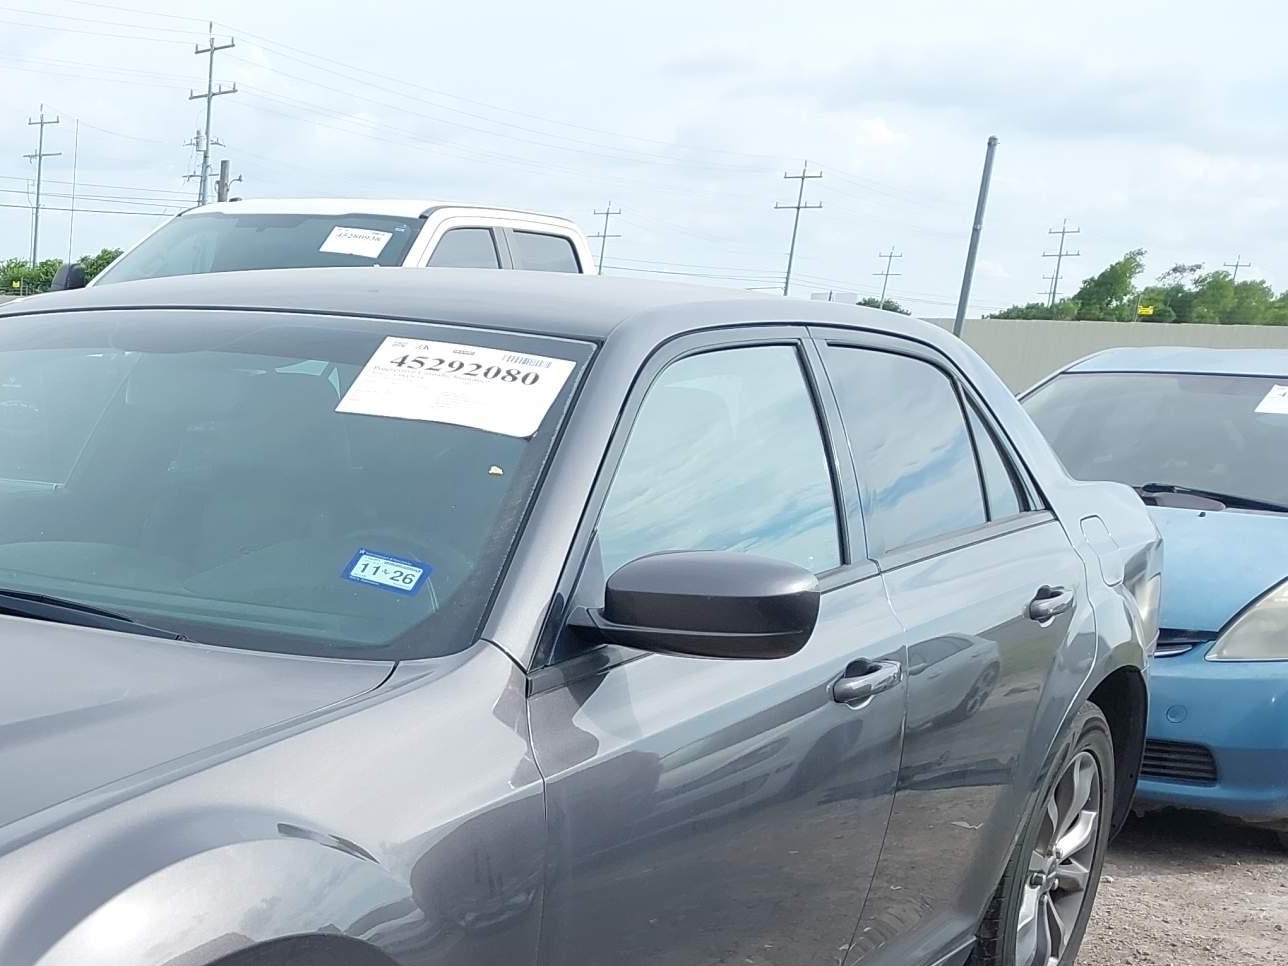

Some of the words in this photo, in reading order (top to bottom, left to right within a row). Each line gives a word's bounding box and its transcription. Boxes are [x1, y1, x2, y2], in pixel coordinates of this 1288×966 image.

[389, 354, 540, 386] 45292080
[360, 562, 382, 576] 11
[389, 570, 416, 585] 26
